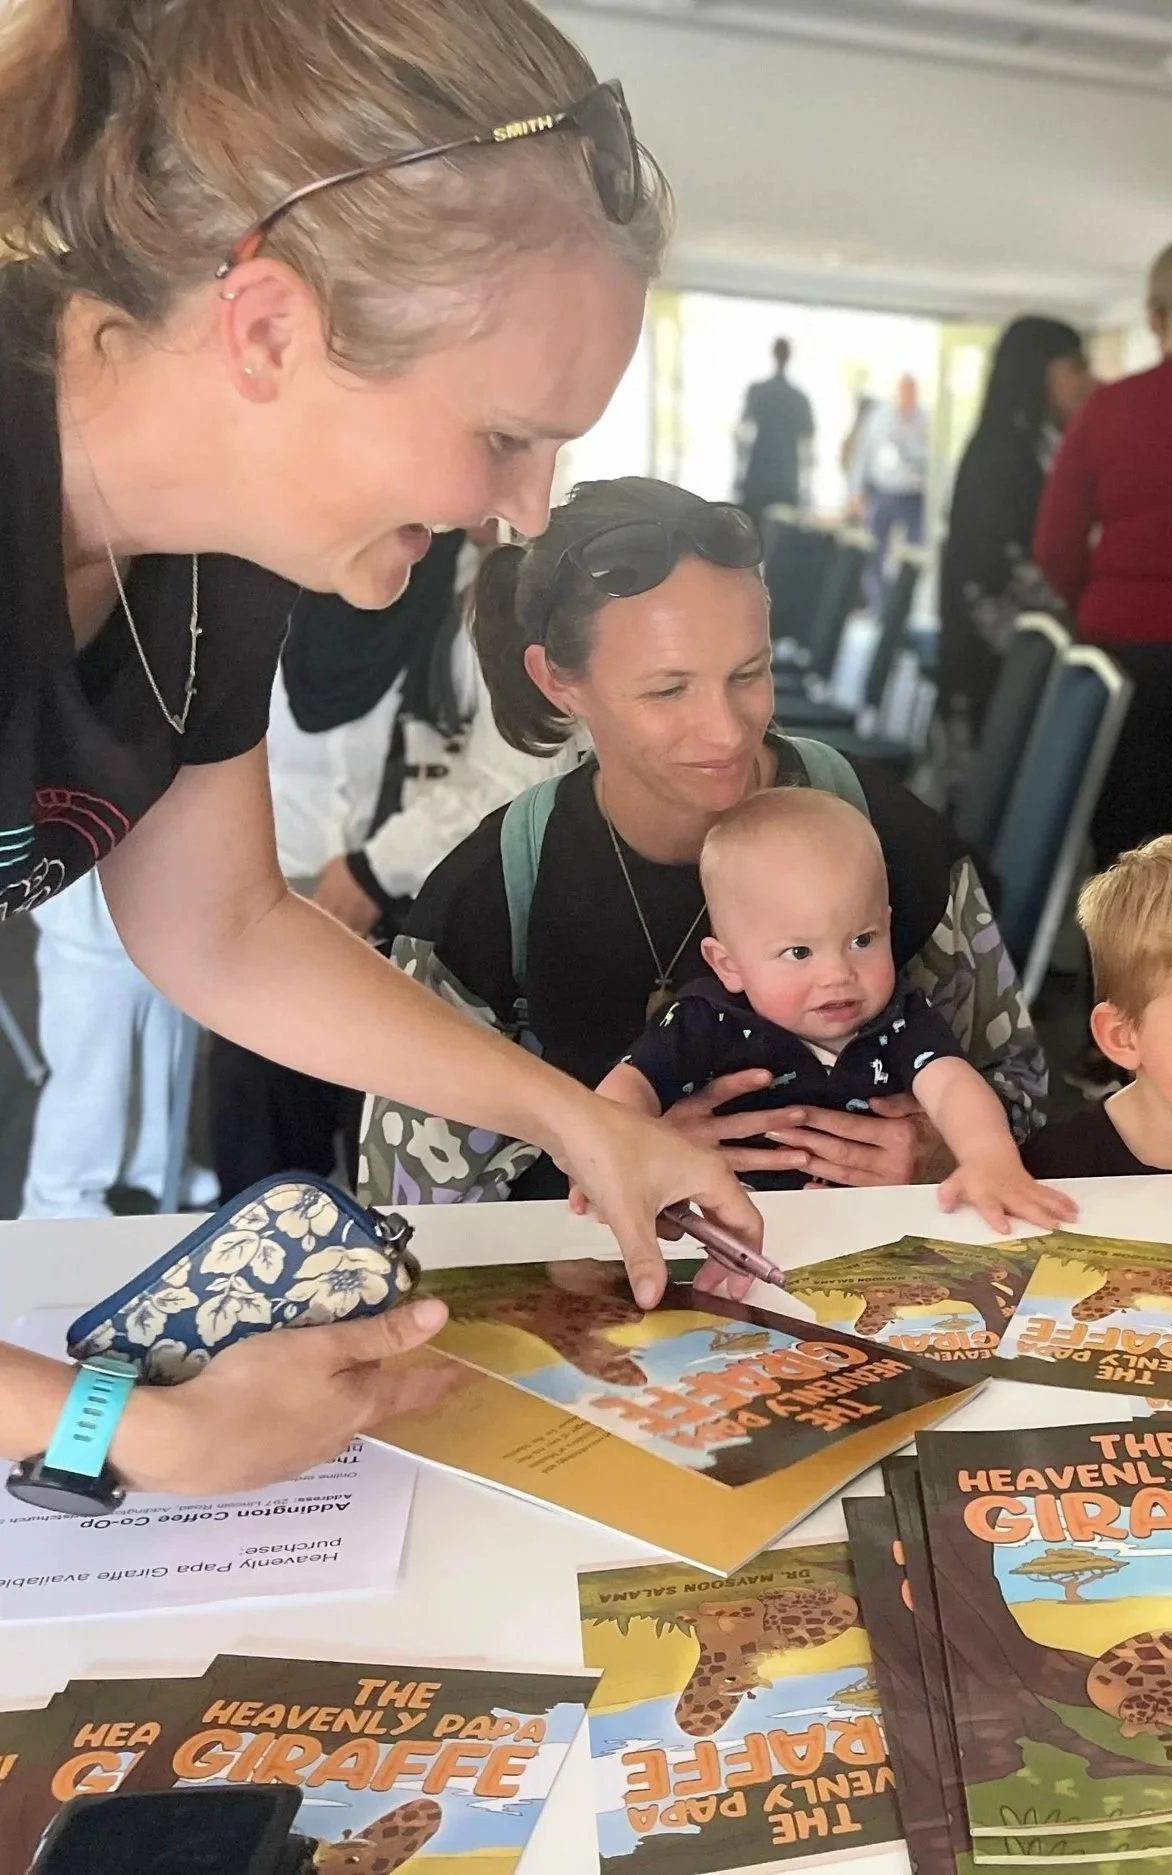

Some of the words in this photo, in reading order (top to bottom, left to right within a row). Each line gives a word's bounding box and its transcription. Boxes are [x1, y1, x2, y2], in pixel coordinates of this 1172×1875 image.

[493, 114, 553, 142] SMITH
[1016, 1341, 1092, 1362] PAPA
[1094, 1364, 1154, 1385] THE
[766, 1358, 912, 1418] HEAVENLY
[794, 1398, 882, 1432] THE
[157, 1511, 229, 1524] Coffee
[237, 1502, 350, 1518] Addington
[80, 1516, 150, 1529] Co-Op
[240, 1538, 342, 1557] purchase:
[176, 1560, 232, 1576] Papa
[240, 1551, 338, 1570] Heavenly
[97, 1567, 168, 1582] Giraffe
[684, 1573, 774, 1593] MAYSOON
[781, 1568, 810, 1579] DR.
[599, 1585, 677, 1604] SALAMA
[353, 1678, 442, 1710] THE
[201, 1699, 427, 1736] HEAVENLY
[433, 1714, 547, 1743] PAPA
[172, 1728, 541, 1797] GIRAFFE
[621, 1715, 886, 1806] RAFFE
[762, 1766, 896, 1812] VENLY
[626, 1791, 746, 1833] PAPA
[768, 1802, 862, 1846] THE
